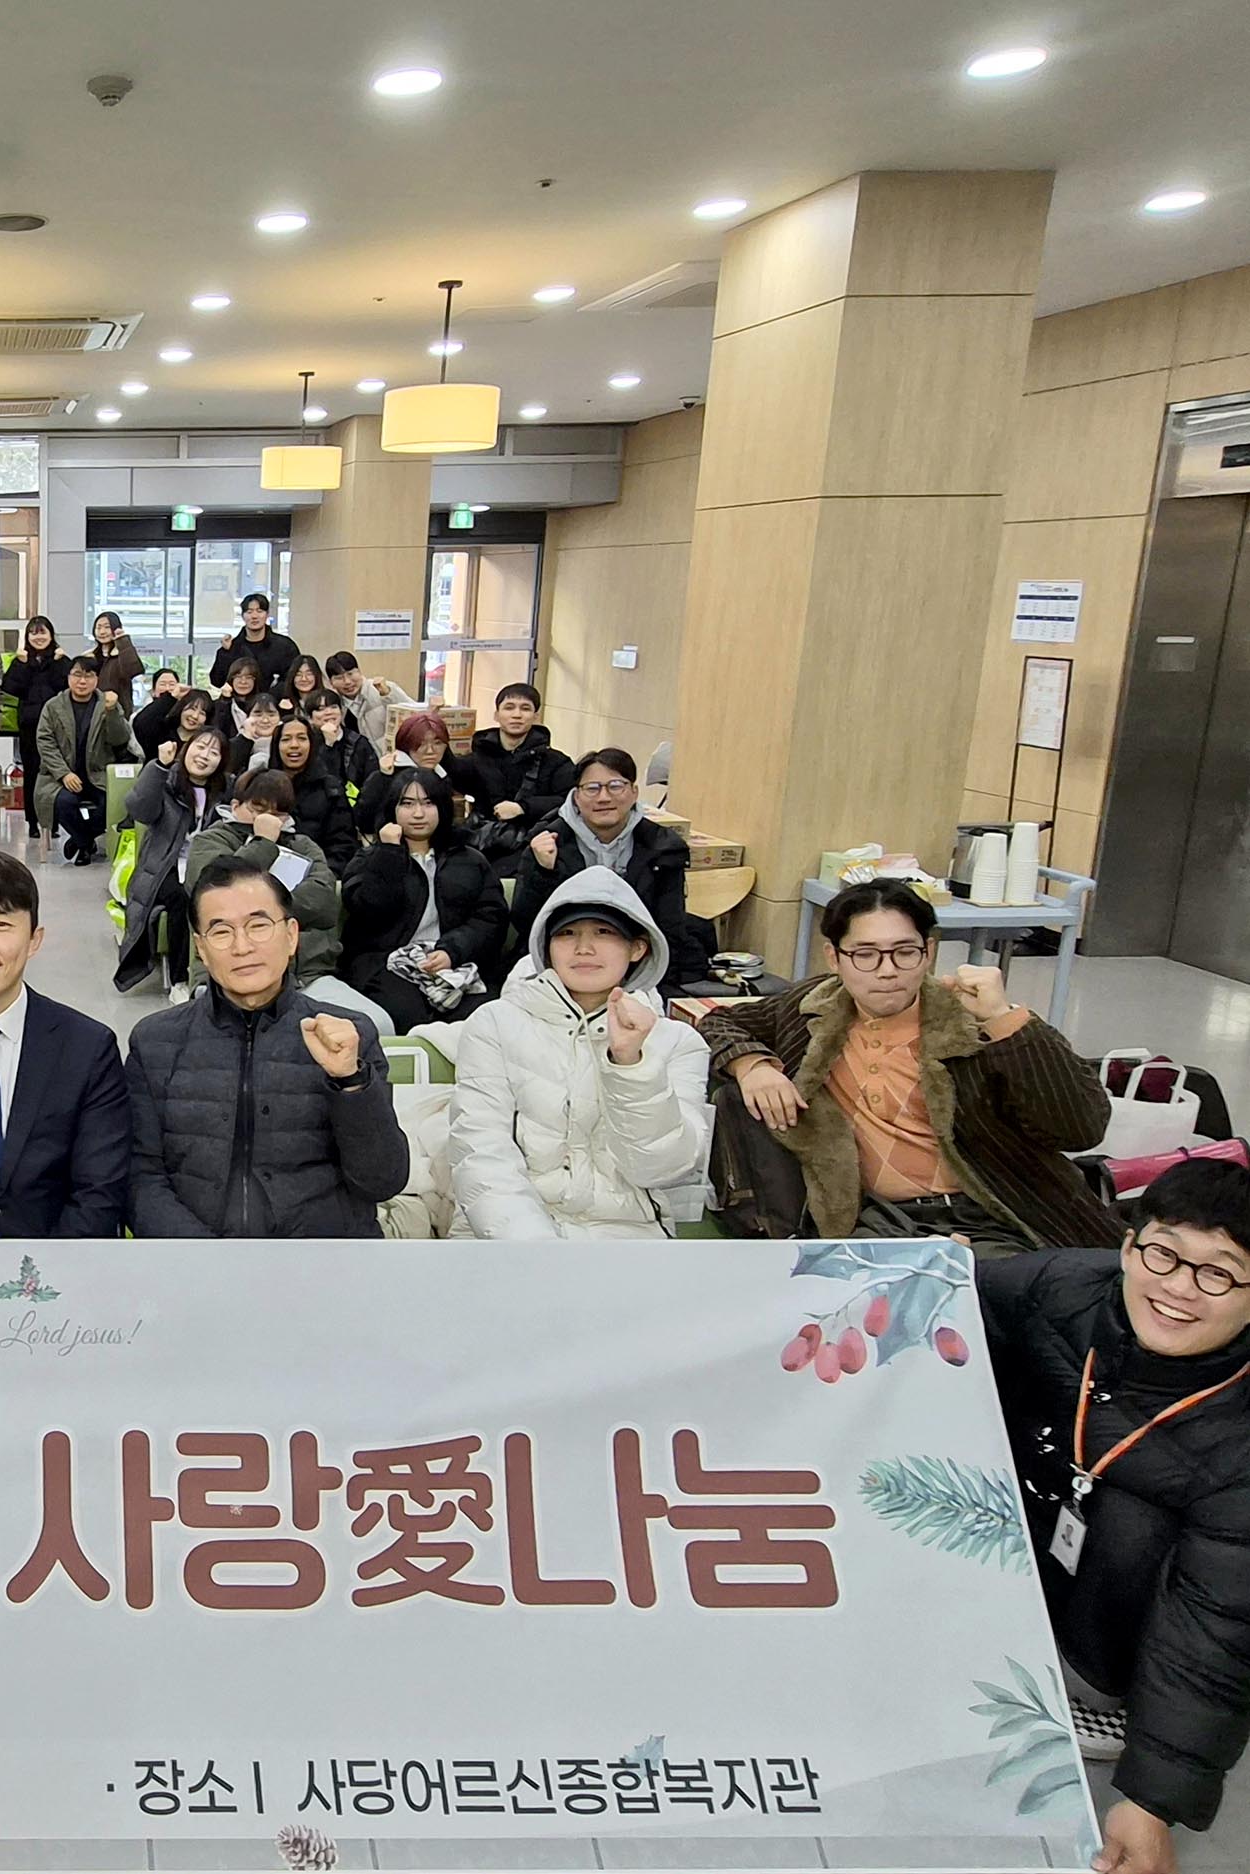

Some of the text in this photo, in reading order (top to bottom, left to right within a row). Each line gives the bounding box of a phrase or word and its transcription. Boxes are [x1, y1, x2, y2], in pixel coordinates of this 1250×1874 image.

[0, 1310, 70, 1354] Lord
[58, 1318, 143, 1357] jesus!
[297, 1757, 822, 1816] 사당어르신종합복지관
